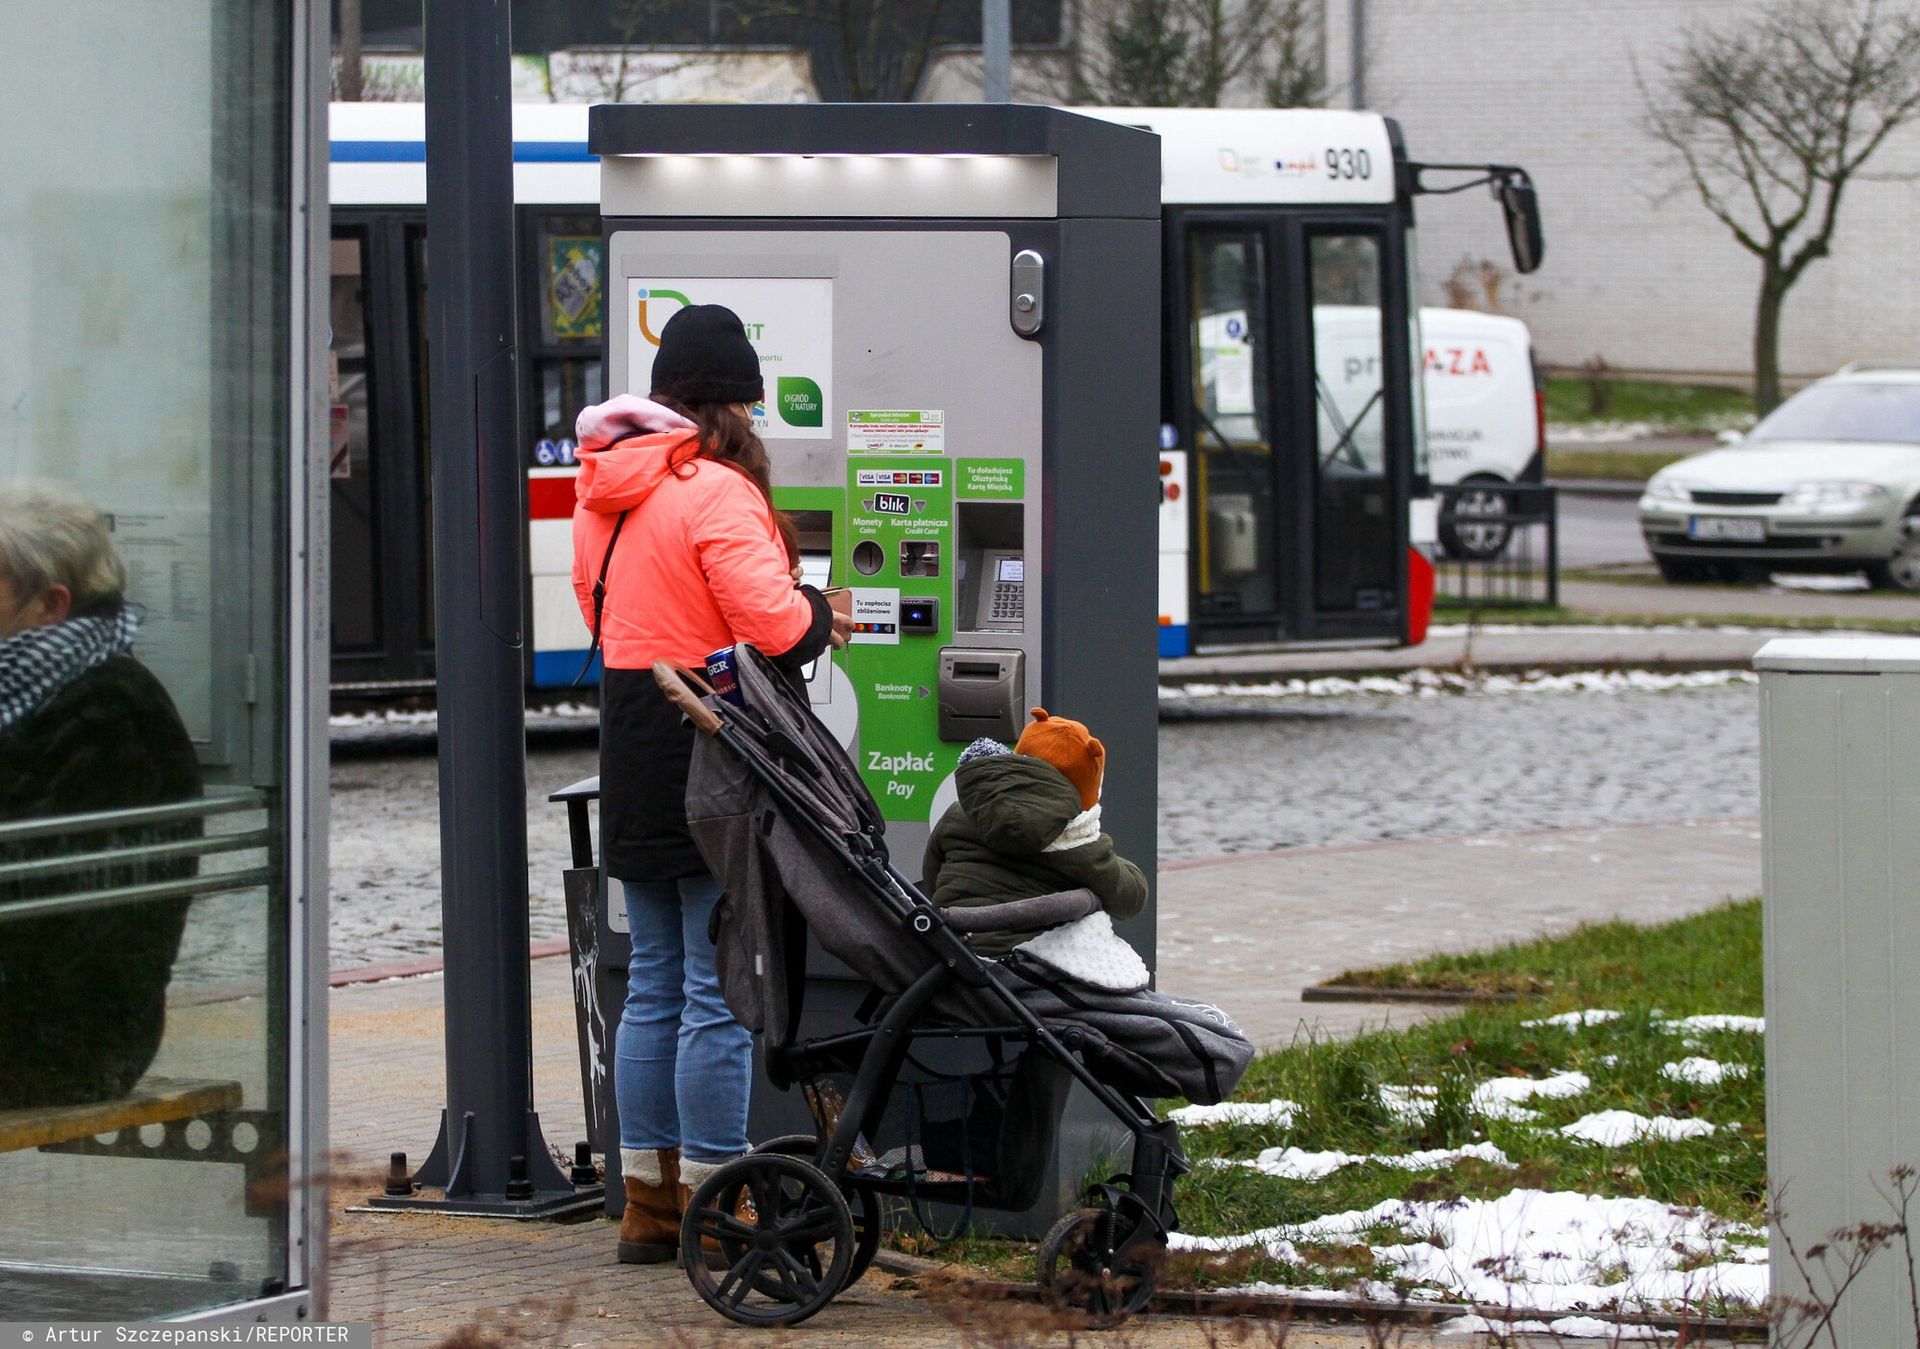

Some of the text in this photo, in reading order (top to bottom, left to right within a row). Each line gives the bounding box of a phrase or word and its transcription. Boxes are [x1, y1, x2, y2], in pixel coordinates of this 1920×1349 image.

[1325, 148, 1371, 180] 930
[743, 323, 764, 340] iT
[790, 403, 817, 411] Z NATURY
[976, 466, 1013, 475] doładujesz
[971, 475, 1009, 484] Olsztyńską
[967, 483, 1013, 492] Kartę Miejską
[880, 495, 905, 512] blik
[853, 518, 883, 528] Monety
[891, 518, 948, 528] Karta płatnicza
[905, 527, 939, 535] Credit Card
[864, 600, 891, 608] zapłacisz
[707, 661, 728, 675] GER
[875, 683, 913, 694] Banknoty
[867, 751, 935, 776] Zapłać
[886, 781, 916, 800] Pay
